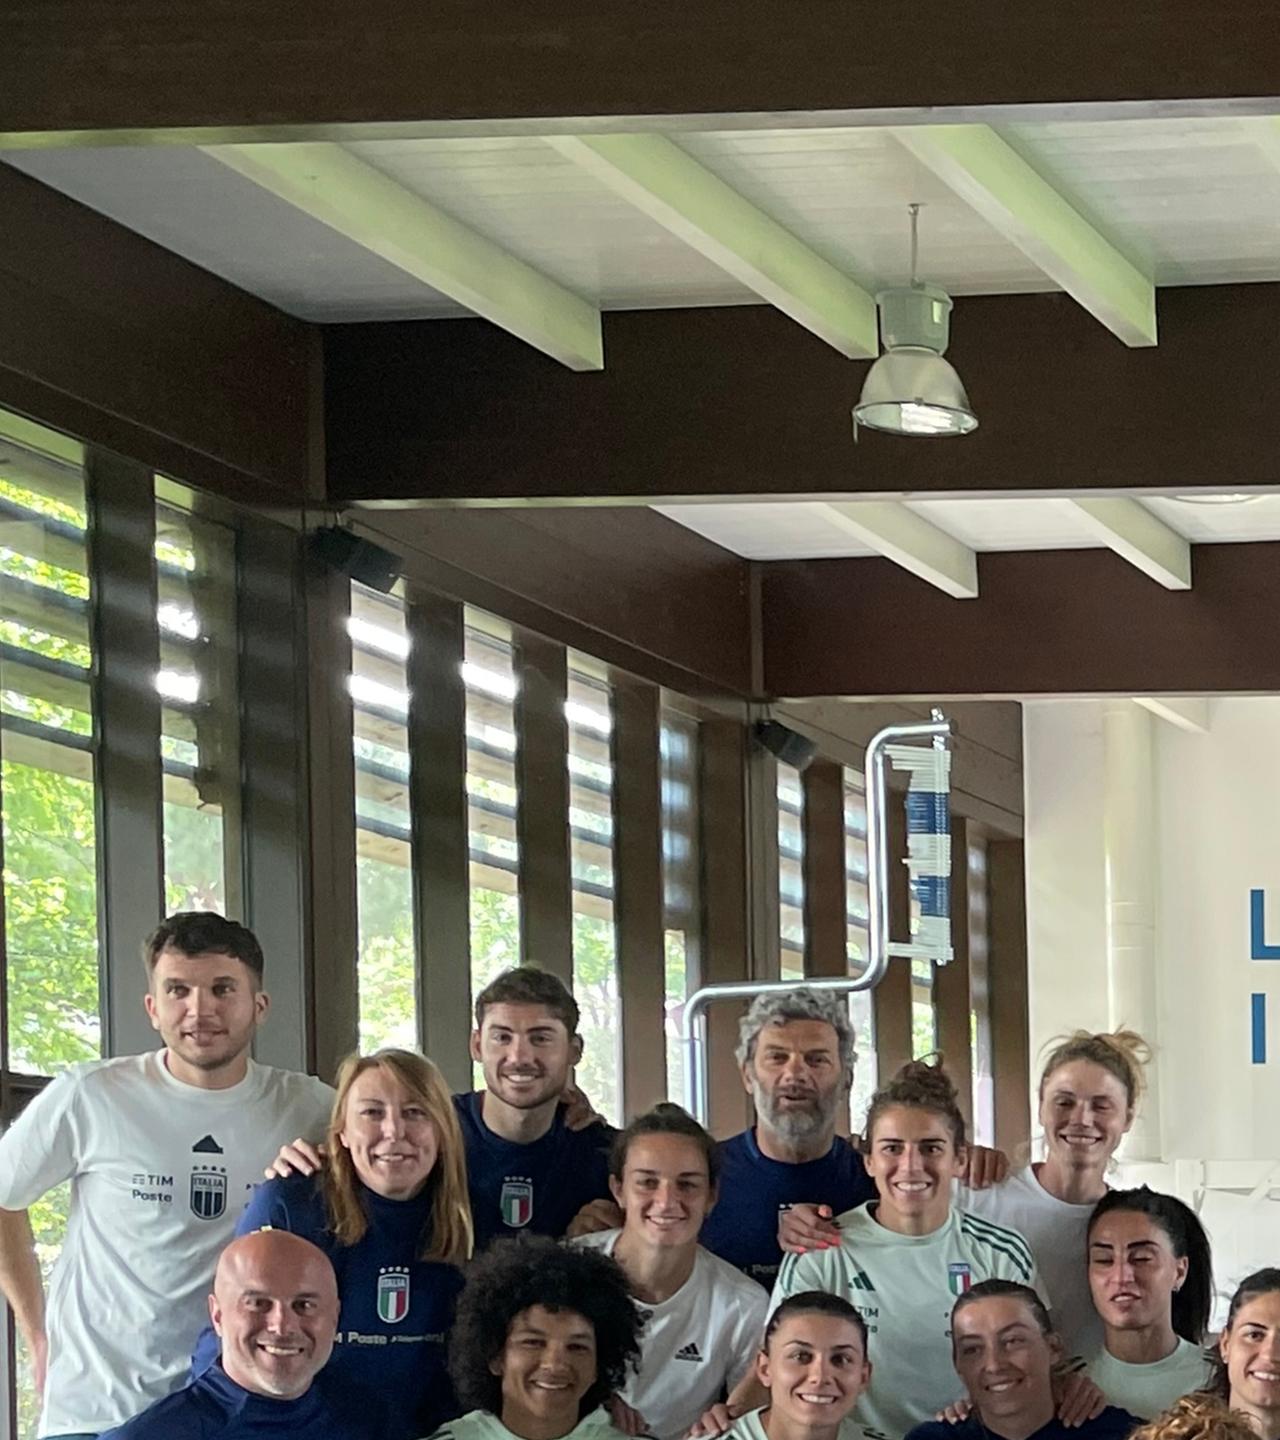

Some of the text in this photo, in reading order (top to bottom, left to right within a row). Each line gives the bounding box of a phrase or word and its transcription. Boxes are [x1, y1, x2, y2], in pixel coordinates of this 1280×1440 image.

[147, 1174, 174, 1186] TIM
[131, 1189, 173, 1202] Poste
[347, 1331, 388, 1346] Poste
